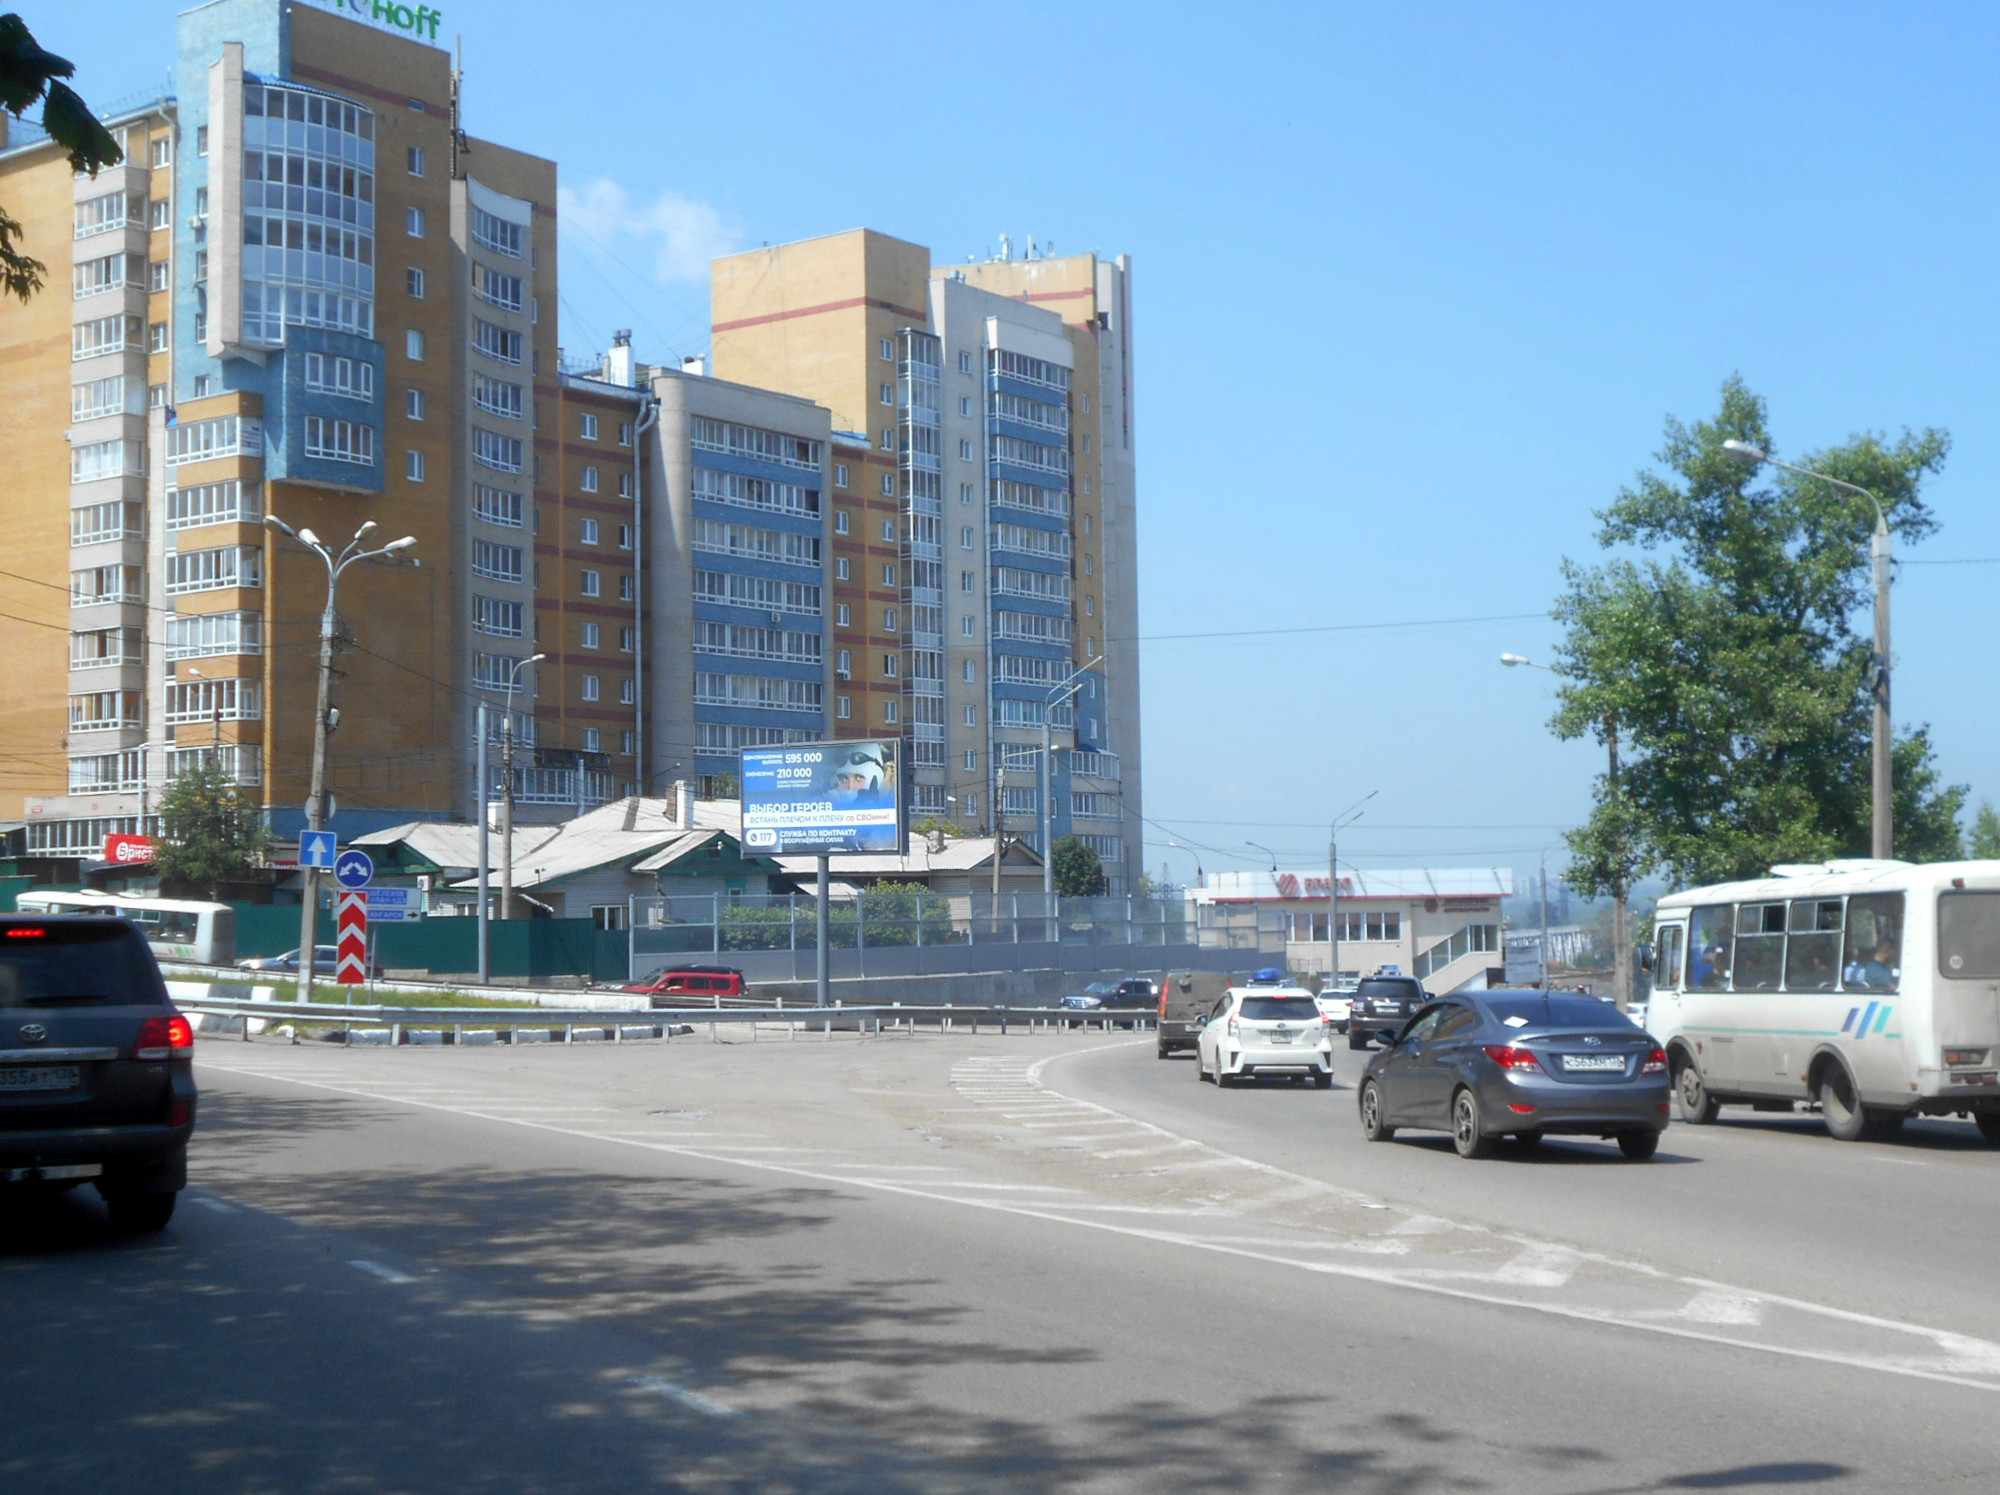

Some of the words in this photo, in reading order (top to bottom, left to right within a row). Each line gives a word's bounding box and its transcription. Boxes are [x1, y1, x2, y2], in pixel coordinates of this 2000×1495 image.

[785, 754, 802, 763] 595
[803, 753, 822, 763] 000
[777, 769, 792, 778] 210
[793, 768, 812, 777] 000
[749, 803, 789, 814] ВЫБОР
[791, 801, 833, 813] ГЕРОЕВ
[750, 816, 778, 824] ВСТАНЬ
[779, 815, 811, 823] ПЛЕЧОМ
[819, 814, 845, 822] ПЛЕЧУ
[856, 813, 890, 822] СВОими!
[759, 832, 772, 842] 117
[818, 829, 857, 837] КОНТРАКТУ
[116, 842, 157, 861] Брист
